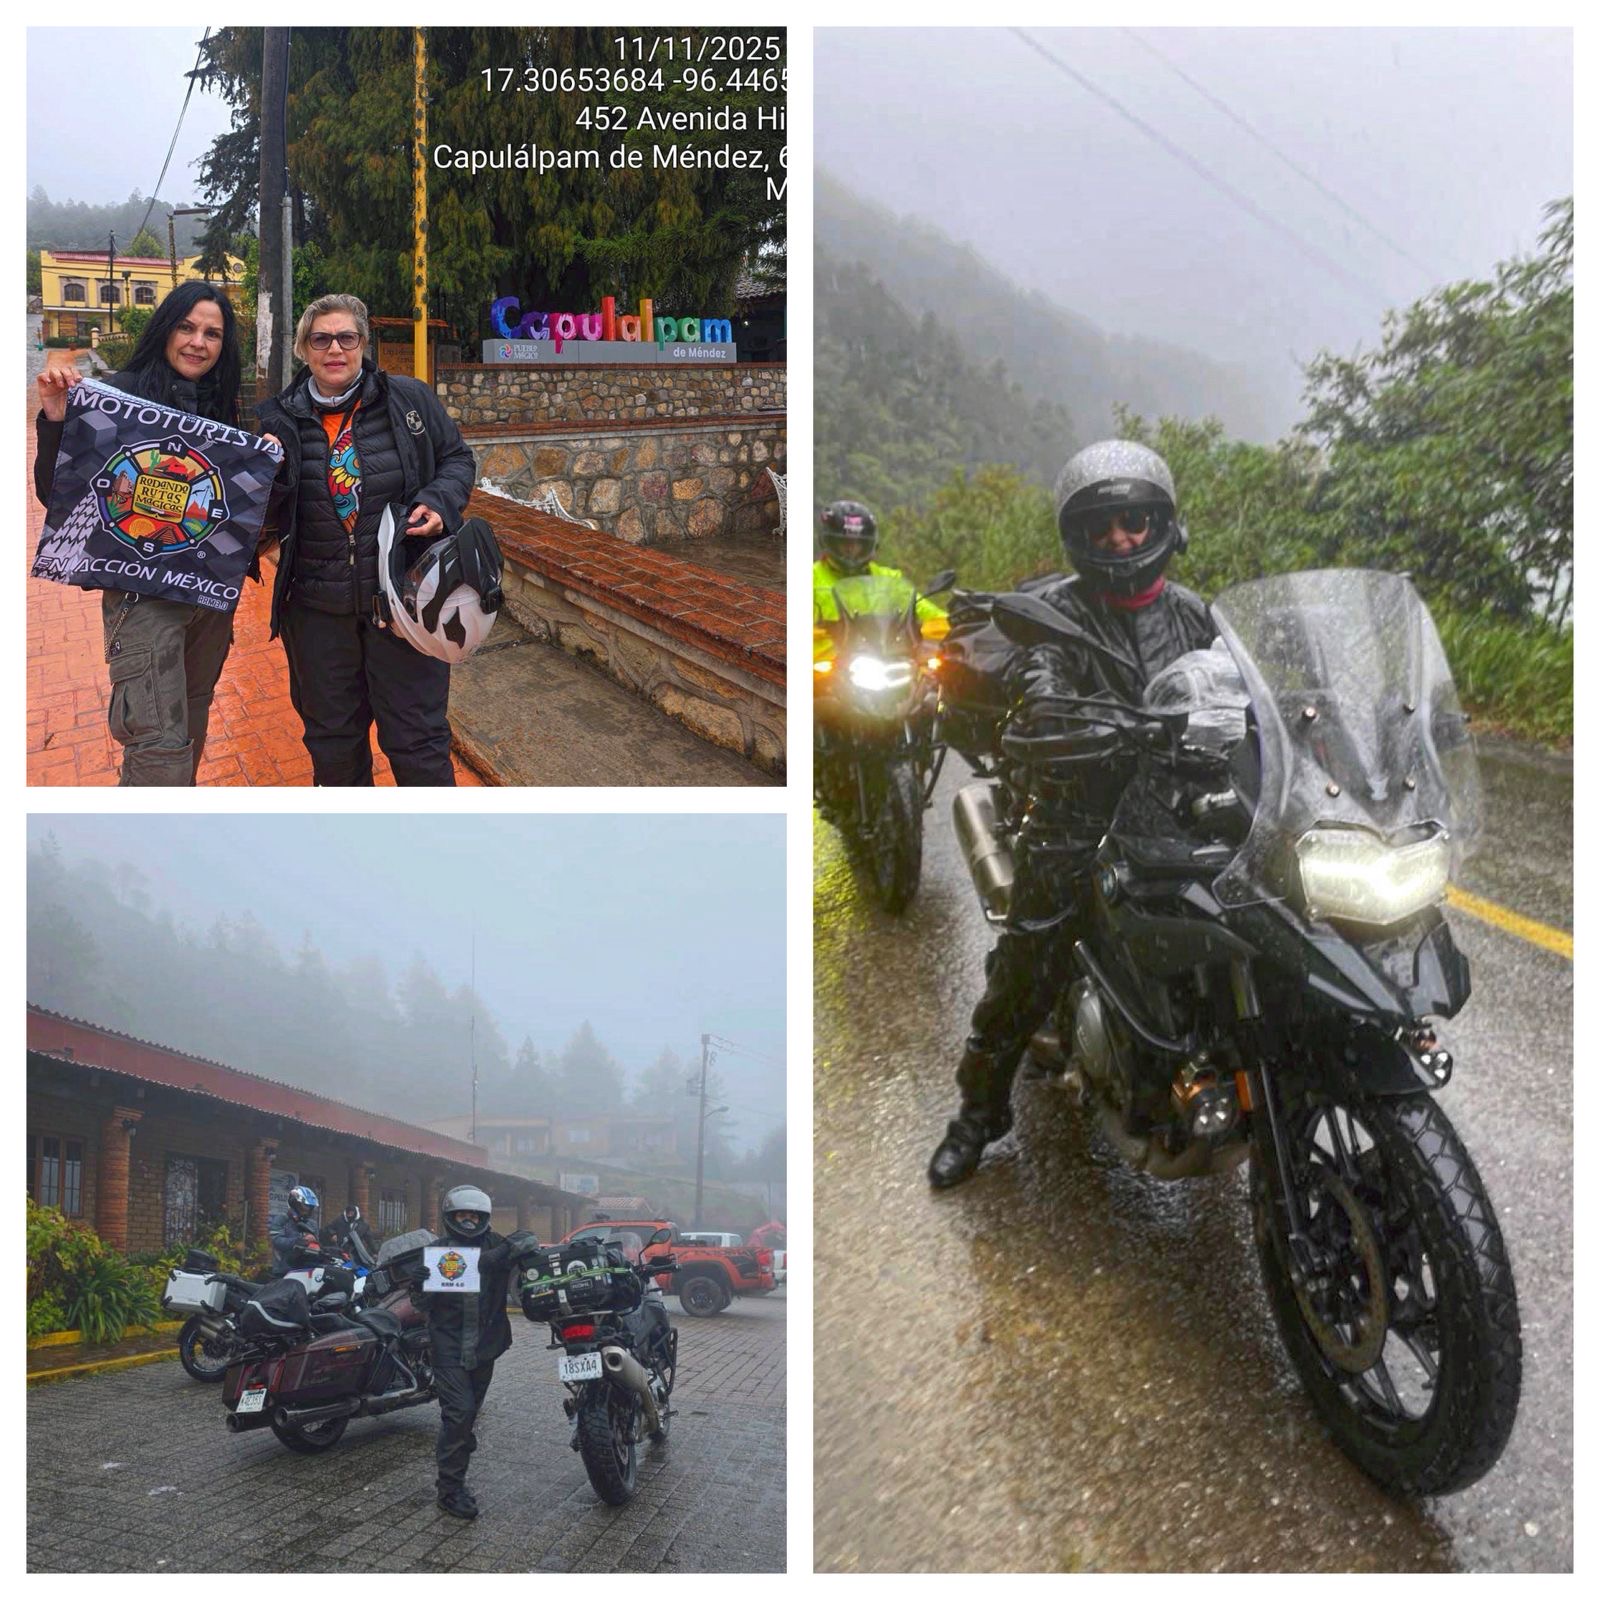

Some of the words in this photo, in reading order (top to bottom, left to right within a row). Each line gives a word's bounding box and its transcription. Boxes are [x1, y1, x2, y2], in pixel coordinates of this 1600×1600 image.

[491, 296, 732, 353] Capulalpam
[673, 346, 686, 357] de
[688, 346, 726, 359] Méndez
[72, 387, 279, 455] MOTOTURISTA
[167, 441, 182, 453] N
[211, 508, 224, 519] E
[142, 541, 155, 553] S
[34, 556, 69, 571] EN
[74, 557, 157, 581] ACCIÓN
[161, 570, 239, 600] MÉXICO
